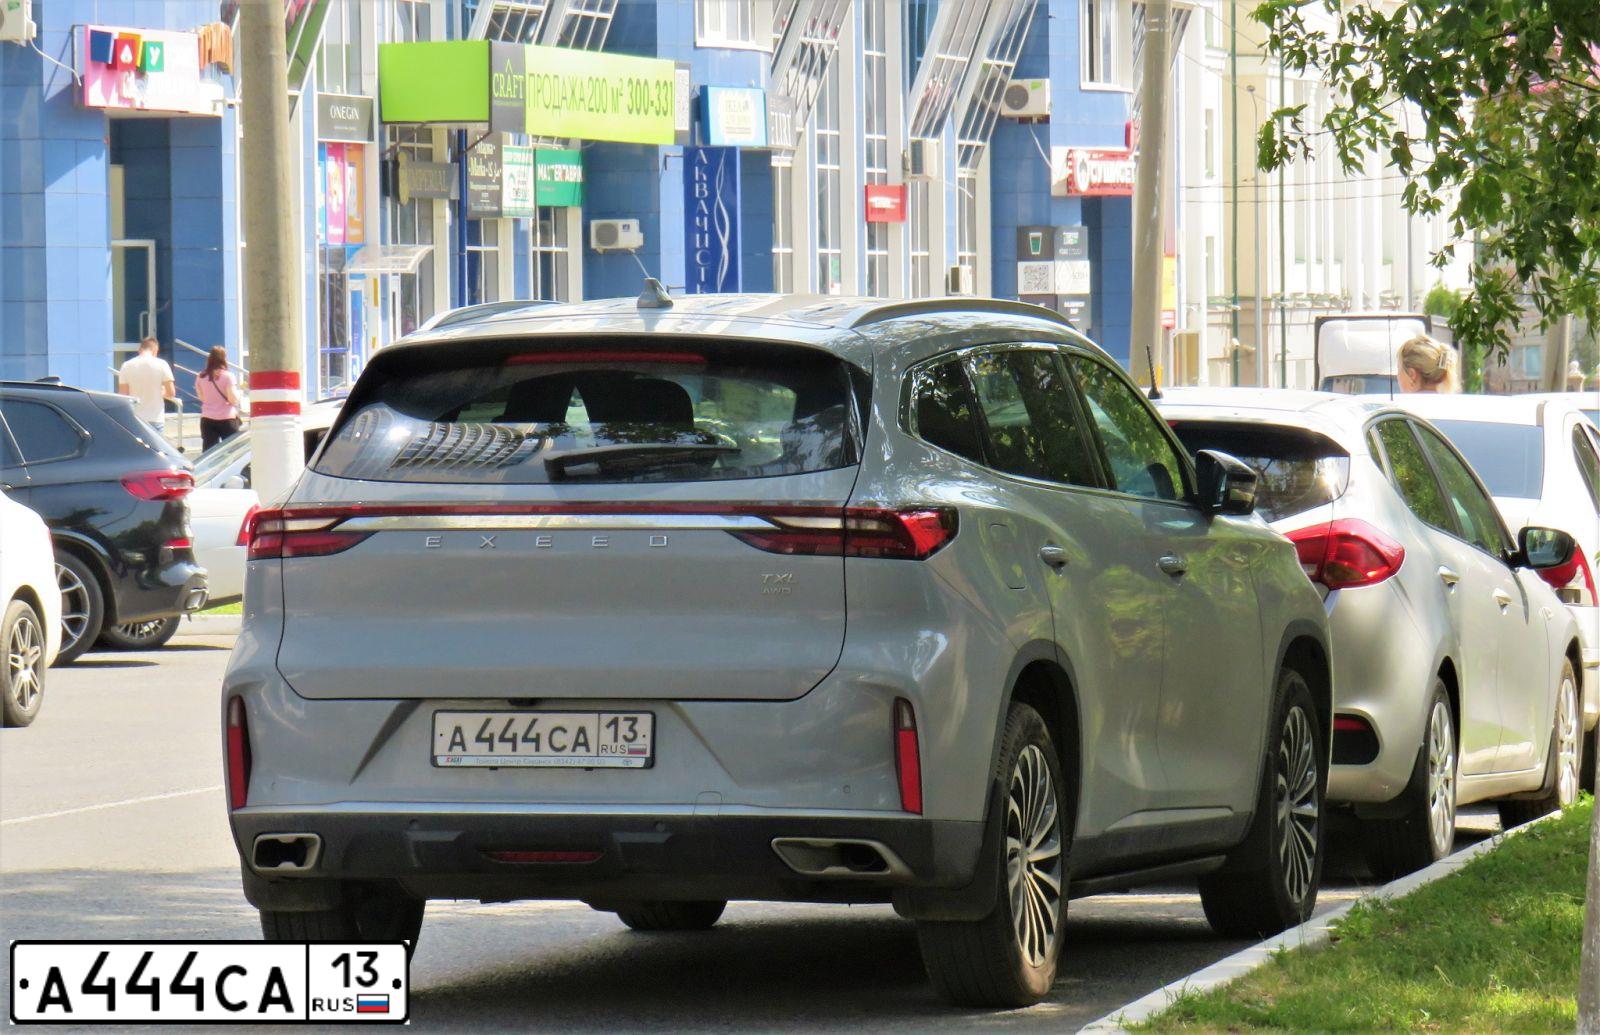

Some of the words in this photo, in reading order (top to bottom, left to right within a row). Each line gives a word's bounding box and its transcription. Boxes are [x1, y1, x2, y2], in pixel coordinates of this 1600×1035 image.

[493, 73, 524, 98] CRAFT
[528, 73, 587, 117] ПРОДАЖА
[588, 76, 608, 114] 200
[627, 77, 674, 116] 300-331
[330, 105, 360, 120] ONEGIN
[425, 535, 668, 548] EXEED
[605, 716, 639, 743] 13
[601, 744, 627, 754] RUS
